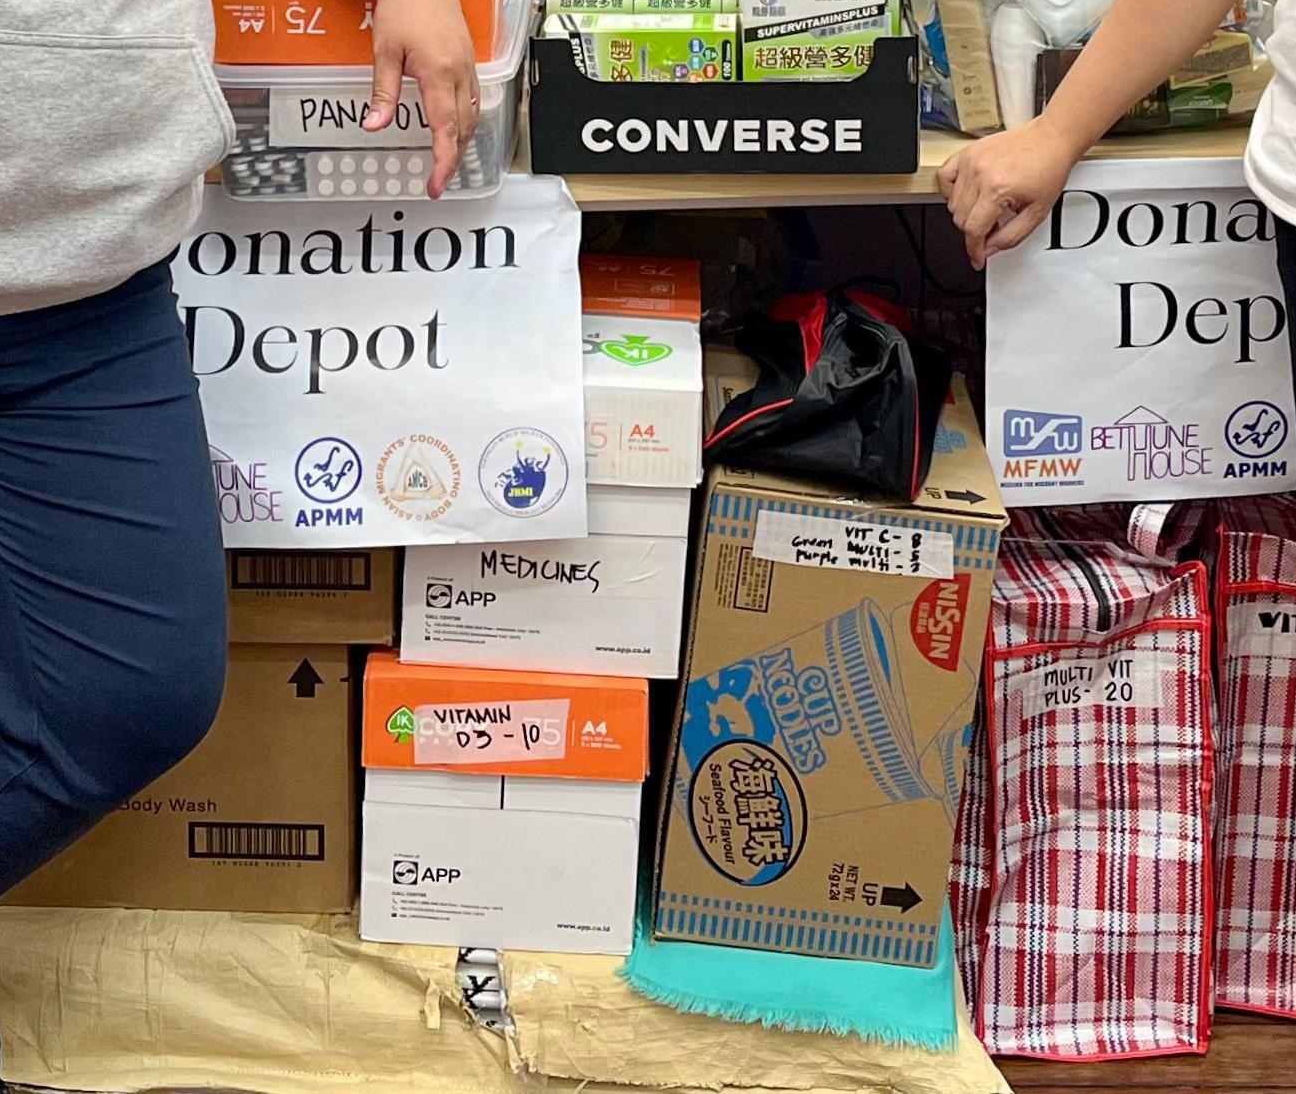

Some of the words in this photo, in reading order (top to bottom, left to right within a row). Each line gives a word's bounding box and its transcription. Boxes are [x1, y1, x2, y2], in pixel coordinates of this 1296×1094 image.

[238, 19, 265, 34] A4
[285, 6, 327, 35] 75
[756, 6, 879, 39] SUPERVITAMINSPLUS
[581, 118, 862, 152] CONVERSE
[1045, 190, 1278, 252] Dona
[171, 210, 520, 276] onation
[1114, 281, 1287, 363] Dep
[181, 306, 450, 395] Depot
[586, 421, 608, 450] 5
[630, 424, 656, 438] A4
[1003, 458, 1082, 478] MFMW
[1223, 461, 1287, 479] APMM
[219, 490, 285, 523] OUSE
[924, 487, 943, 501] UP
[295, 507, 363, 527] APMM
[845, 526, 874, 542] VIT
[481, 549, 602, 594] MEDICINES
[455, 591, 497, 607] APP
[927, 582, 961, 661] NISSIN
[595, 645, 651, 655] www.app.co.id
[1044, 666, 1093, 688] MULTI
[1107, 659, 1134, 680] VIT
[798, 665, 843, 736] CUP
[1104, 681, 1134, 703] 20
[434, 704, 513, 725] VITAMIN
[581, 720, 608, 735] A4
[522, 722, 540, 750] 10
[169, 798, 217, 813] Wash
[709, 763, 730, 820] Seafood
[698, 795, 719, 844] シーフード
[729, 758, 790, 866] 海鮮味
[719, 821, 736, 866] Flavour
[421, 868, 461, 883] APP
[849, 865, 861, 883] NET
[861, 882, 880, 906] UP
[557, 921, 611, 933] www.app.co.id
